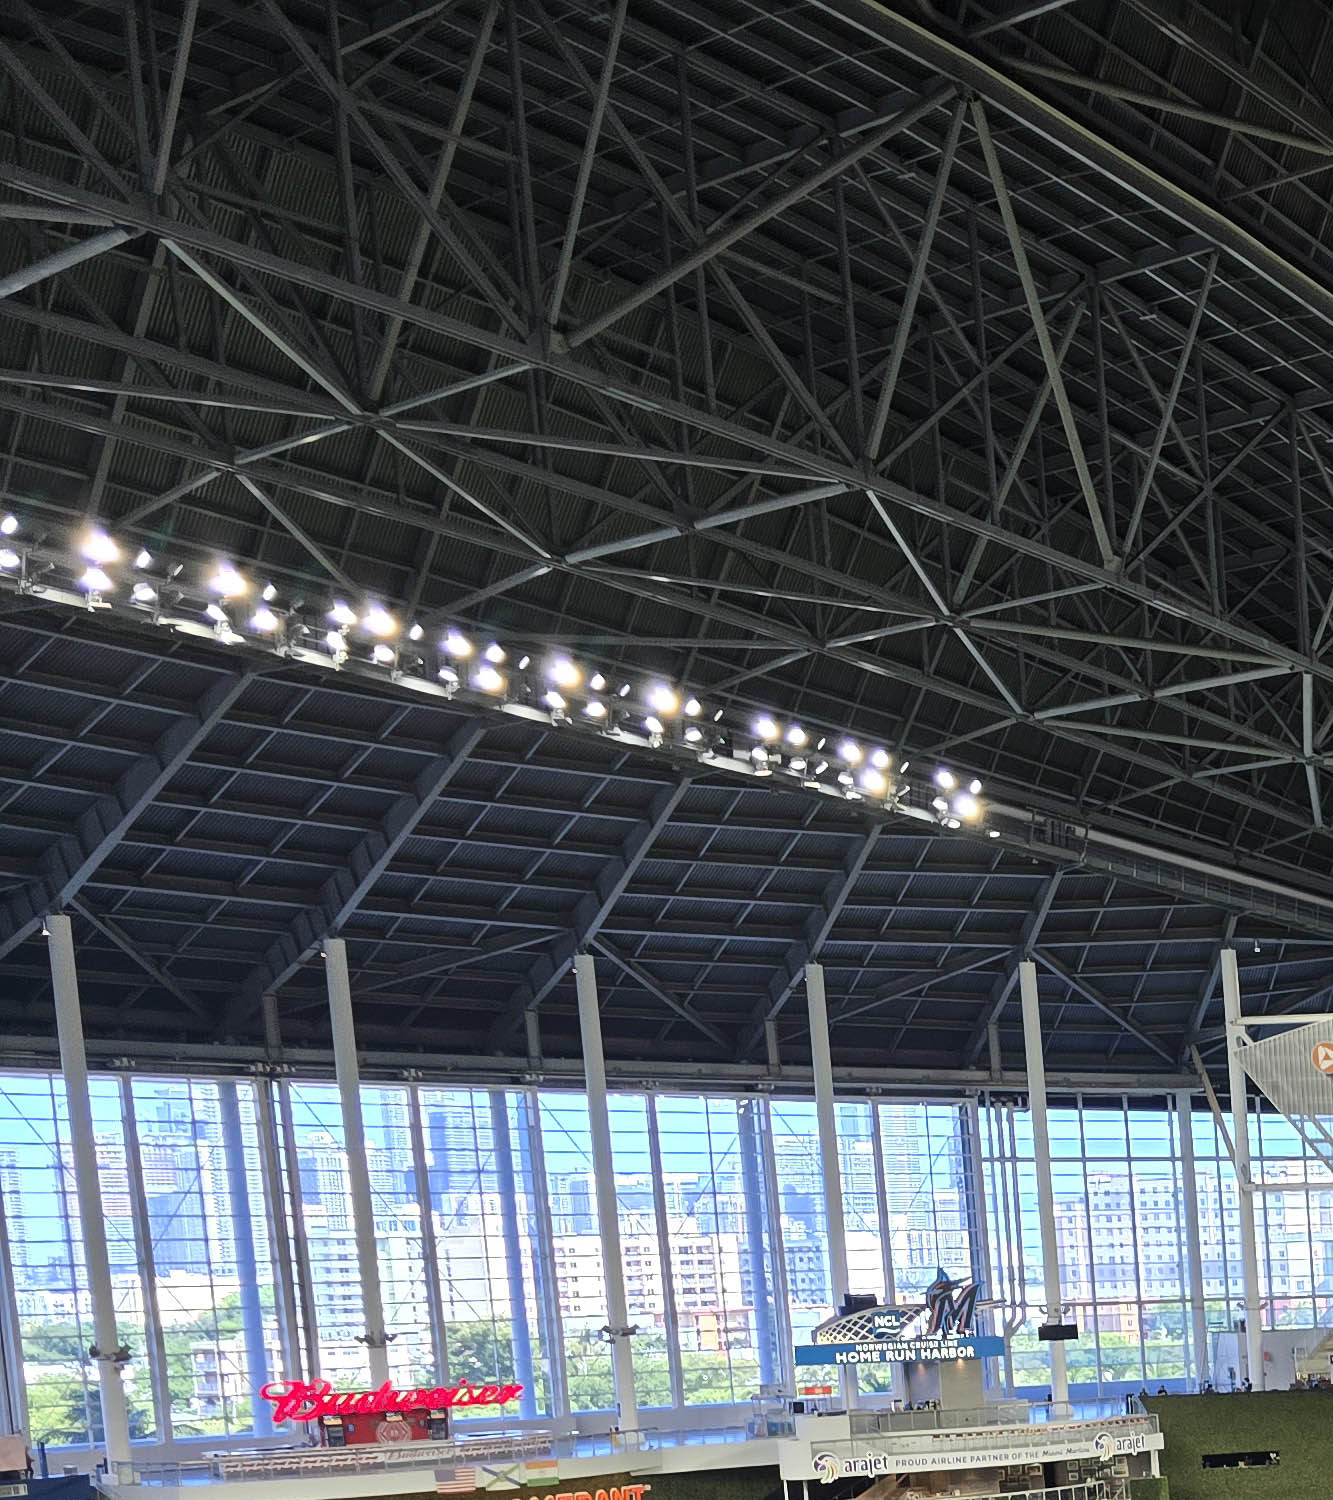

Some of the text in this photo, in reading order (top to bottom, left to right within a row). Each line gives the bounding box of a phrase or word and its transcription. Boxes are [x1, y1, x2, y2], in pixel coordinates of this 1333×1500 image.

[874, 1315, 899, 1327] NCL
[835, 1346, 975, 1364] HOME RUN HARBOR
[855, 1342, 908, 1352] NORWEGIAN
[910, 1340, 940, 1349] CRUISE
[260, 1377, 525, 1424] Budweiser
[1116, 1435, 1146, 1455] arajet
[844, 1453, 889, 1478] arajet
[896, 1457, 928, 1468] PROUD
[931, 1455, 968, 1466] AIRLINE
[970, 1452, 1009, 1463] PARTNER
[1012, 1452, 1023, 1461] OF
[1025, 1451, 1040, 1459] THE
